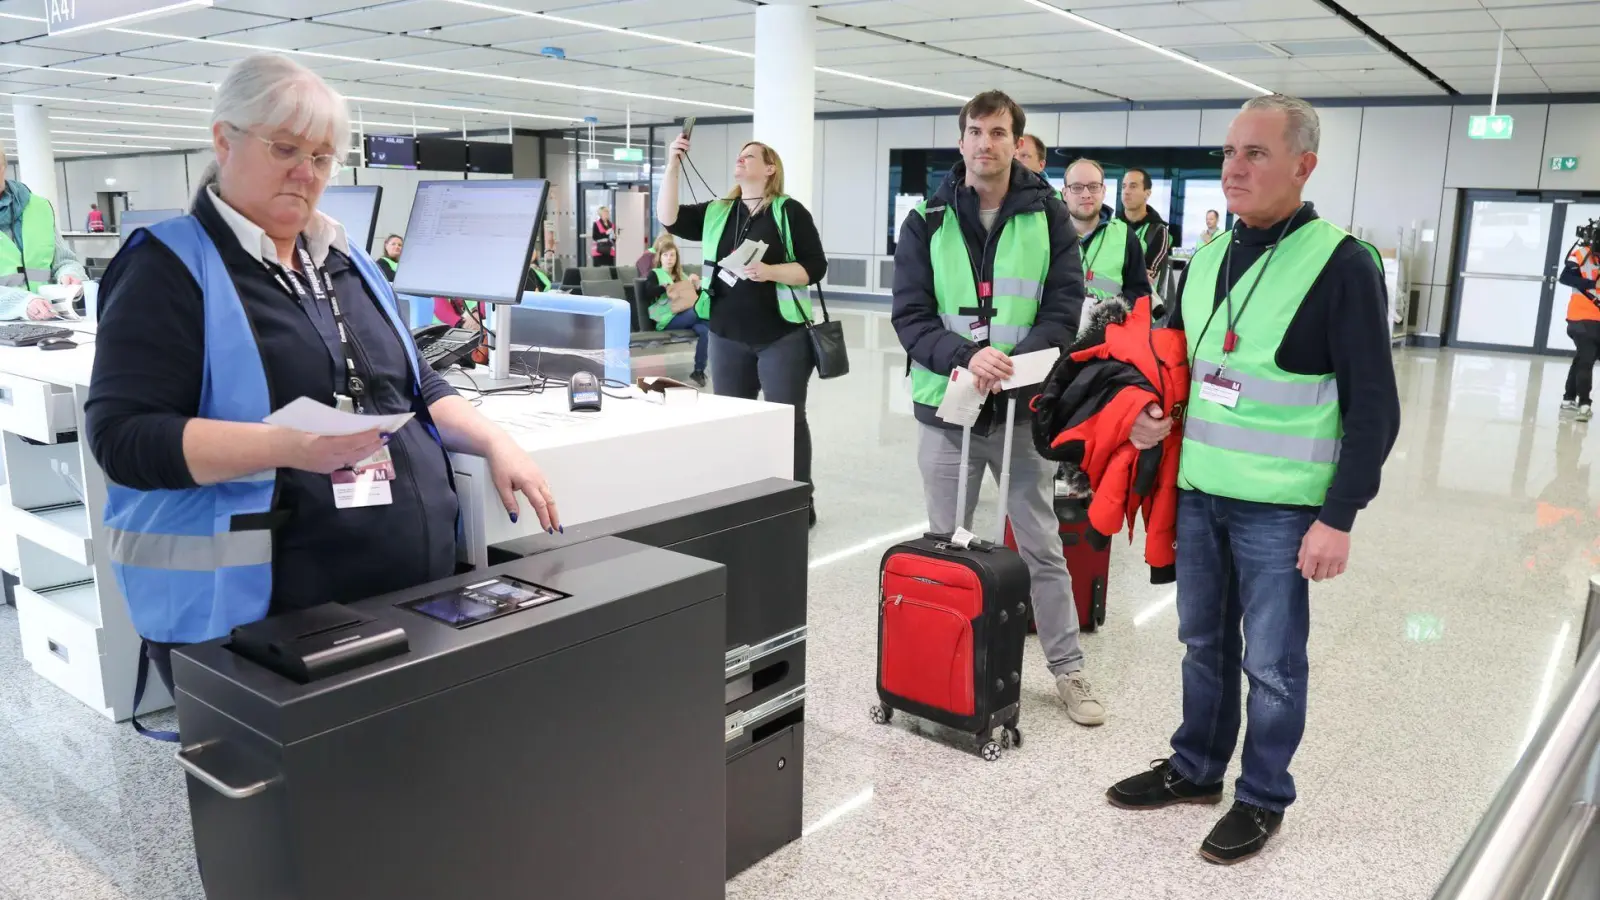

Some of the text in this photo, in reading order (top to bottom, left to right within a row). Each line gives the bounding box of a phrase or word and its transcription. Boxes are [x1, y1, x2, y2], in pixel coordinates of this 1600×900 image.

[305, 265, 324, 294] Terminal
[1231, 382, 1240, 391] M
[375, 469, 386, 480] M
